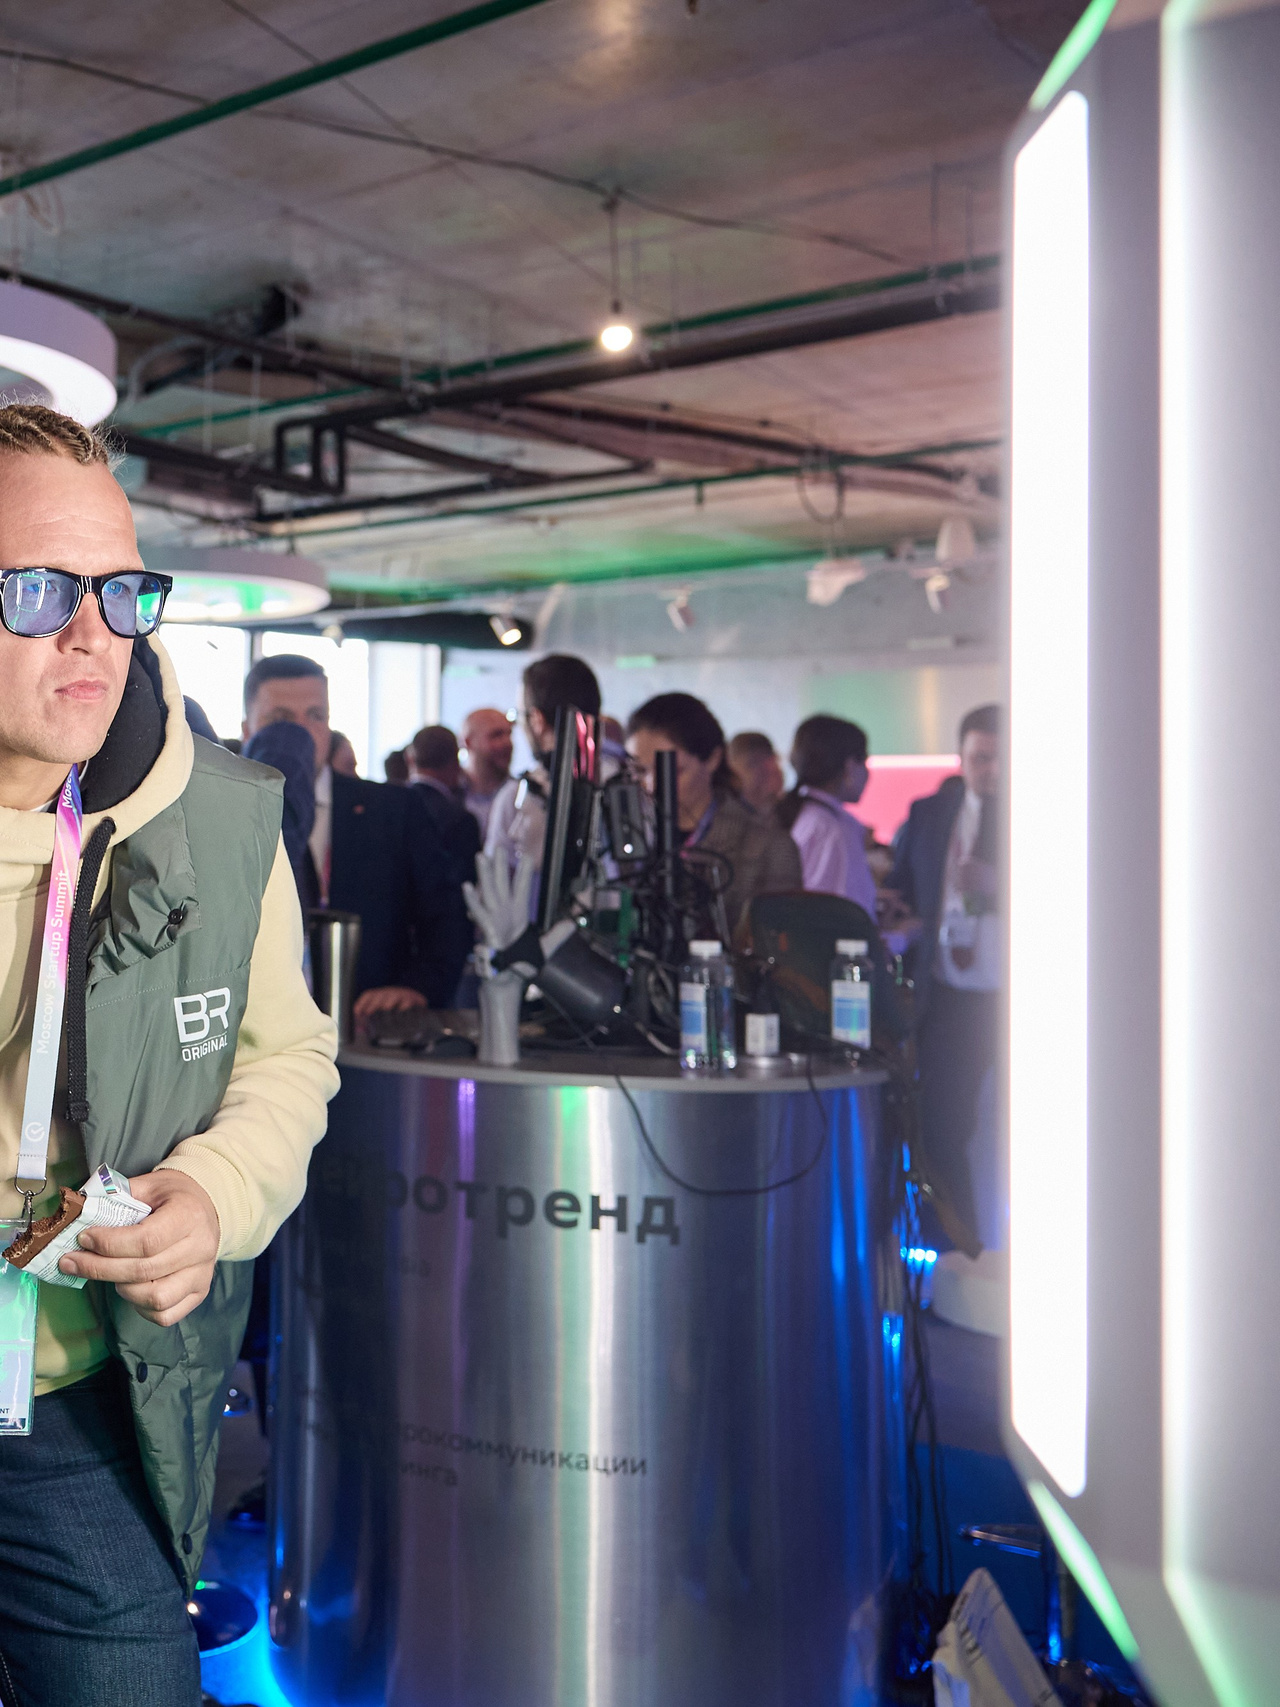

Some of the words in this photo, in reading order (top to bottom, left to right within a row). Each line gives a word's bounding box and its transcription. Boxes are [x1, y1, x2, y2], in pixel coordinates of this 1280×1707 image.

[51, 870, 69, 928] Summit
[44, 931, 64, 990] Startup
[36, 993, 55, 1054] Moscow
[174, 987, 231, 1043] BR
[182, 1034, 228, 1062] ORIGINAL
